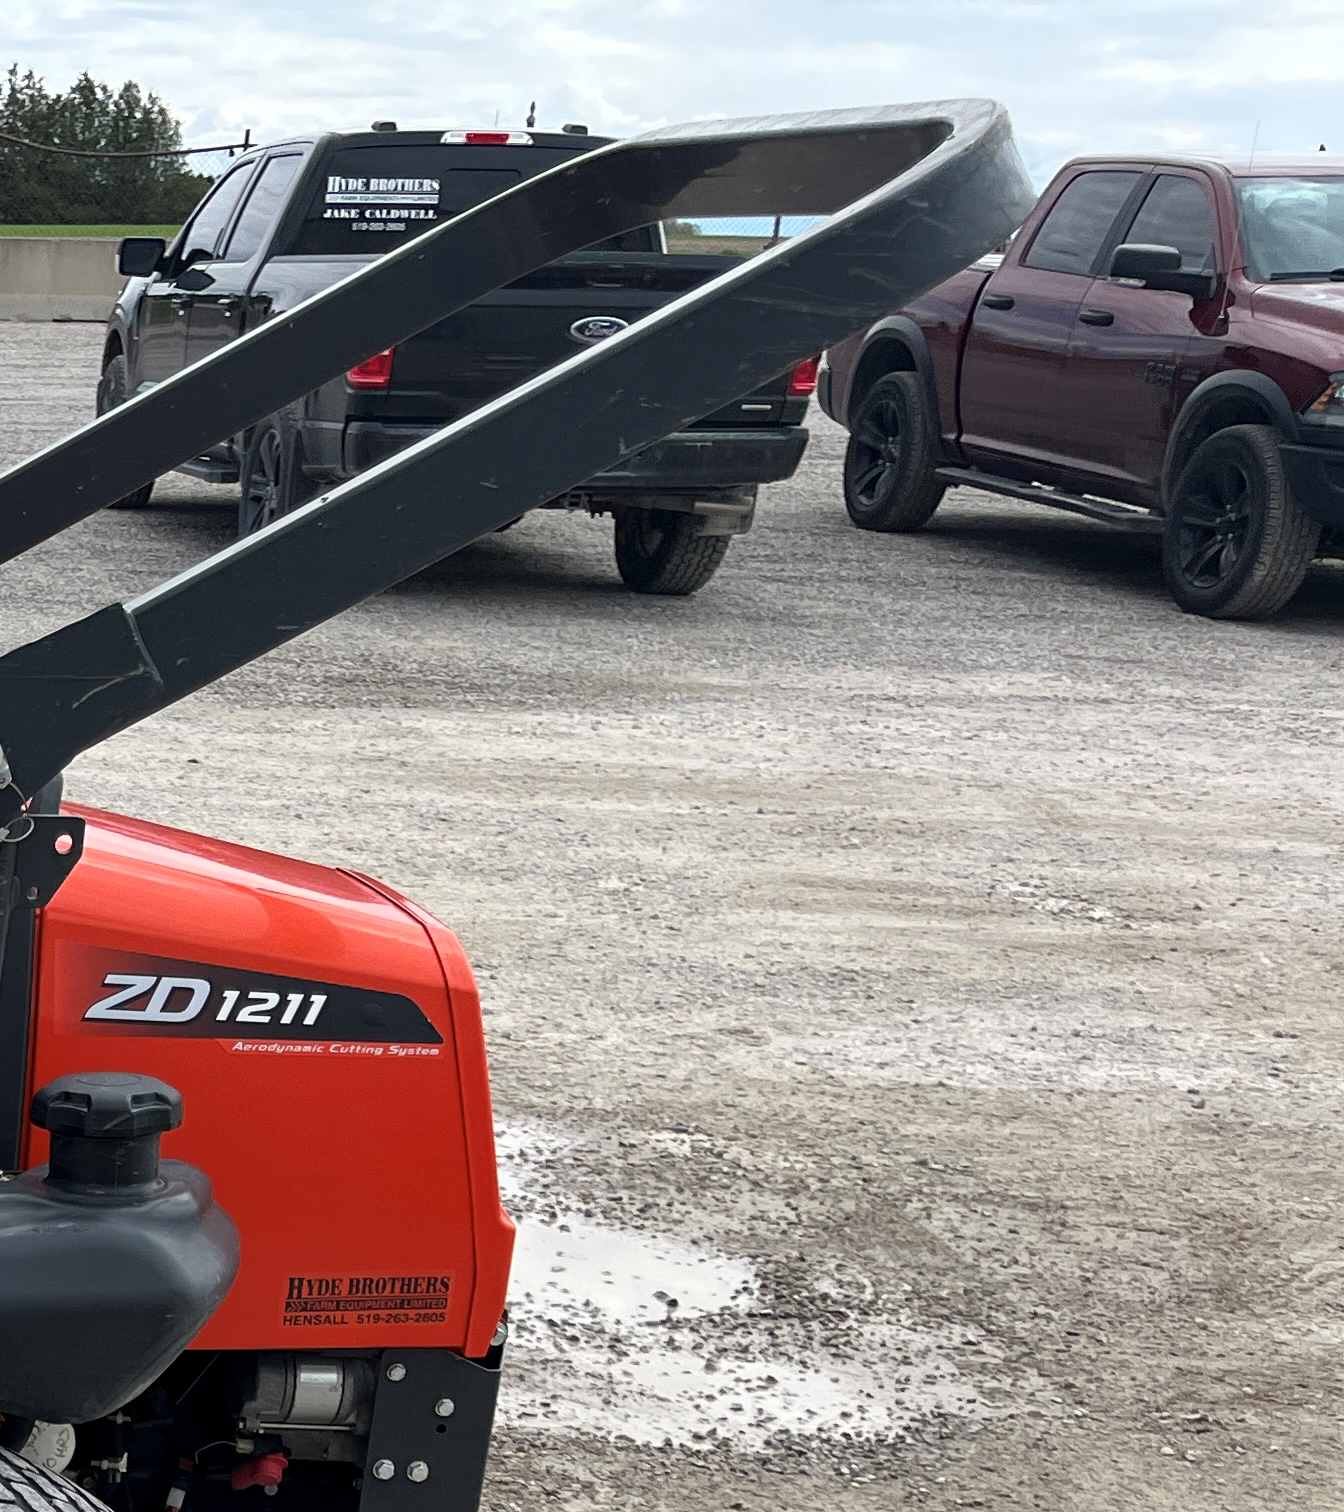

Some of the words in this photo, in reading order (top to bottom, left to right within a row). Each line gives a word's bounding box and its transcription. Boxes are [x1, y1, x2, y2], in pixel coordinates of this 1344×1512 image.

[327, 176, 367, 193] HYDE
[369, 178, 440, 192] BROTHERS
[323, 208, 360, 219] JAKE
[365, 208, 438, 220] CALDWELL
[83, 974, 211, 1023] ZD
[215, 990, 328, 1025] 1211
[232, 1041, 323, 1054] Aerodynamic
[329, 1043, 384, 1056] Cutting
[387, 1045, 440, 1056] System
[288, 1277, 343, 1299] HYDE
[348, 1276, 450, 1296] BROTHERS
[307, 1301, 337, 1311] FARM
[340, 1299, 402, 1311] EQUIPMENT
[404, 1298, 447, 1310] LIMITED
[283, 1314, 348, 1326] HENSALL
